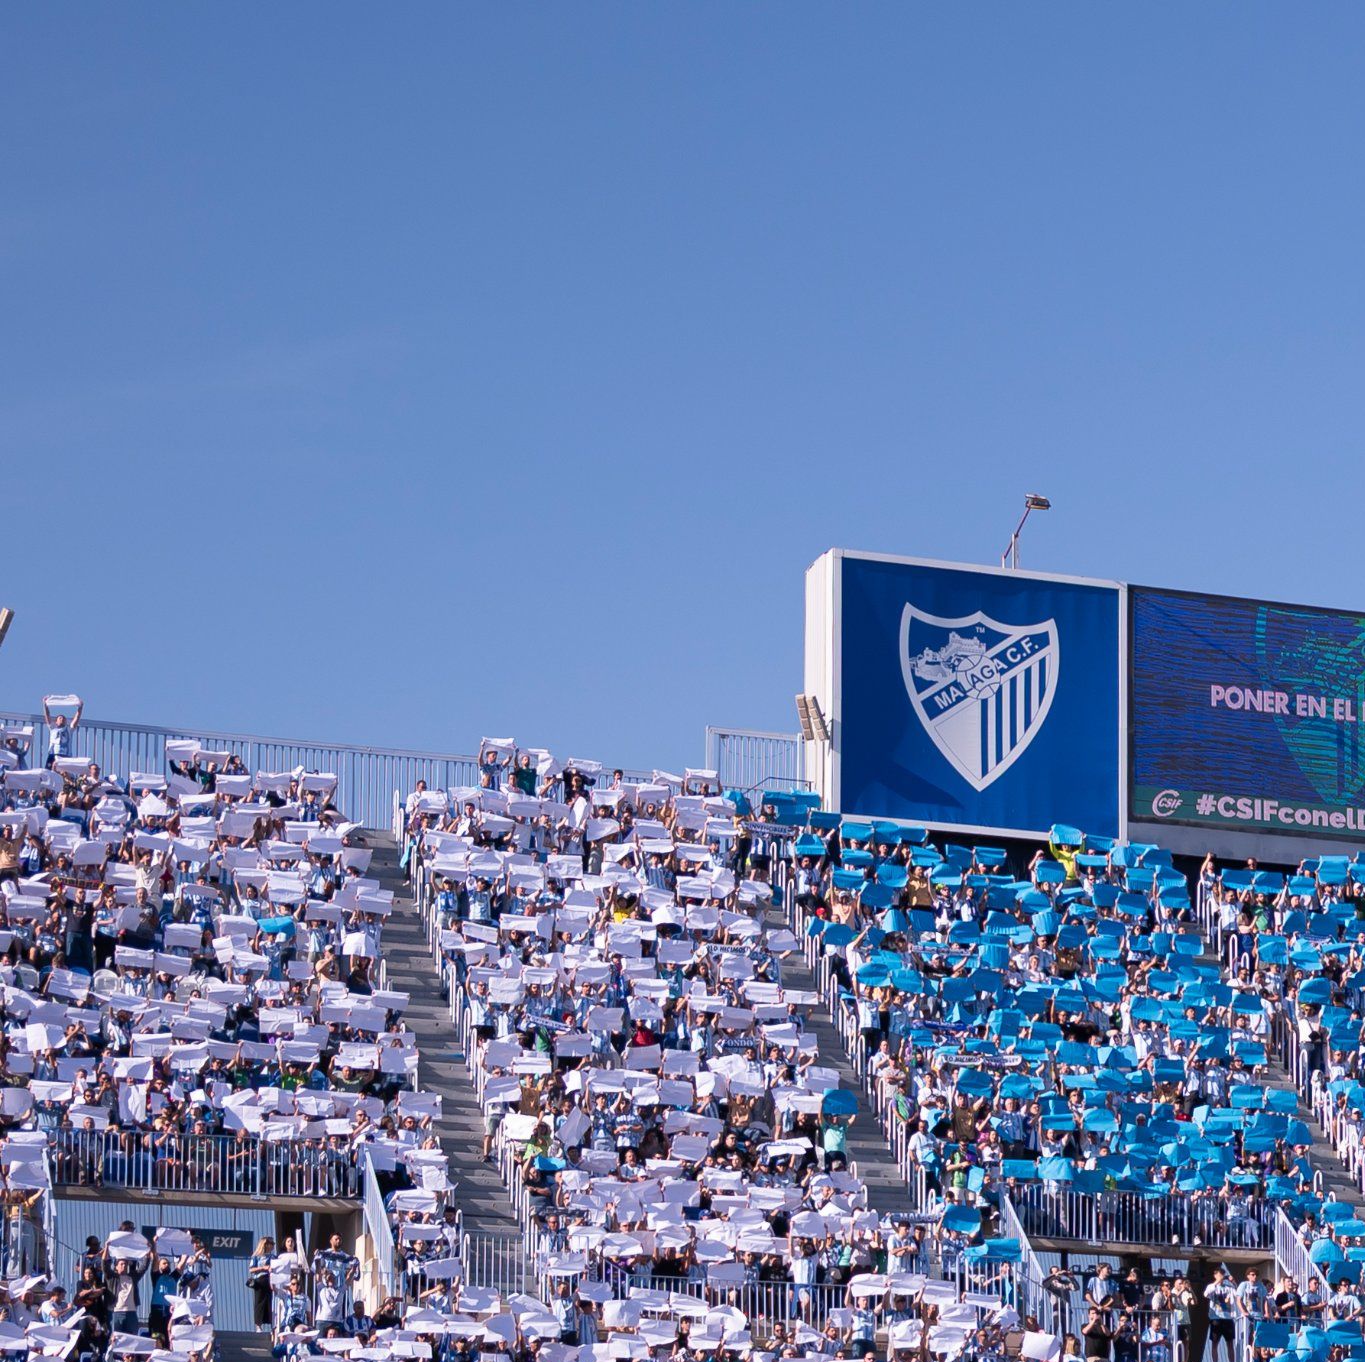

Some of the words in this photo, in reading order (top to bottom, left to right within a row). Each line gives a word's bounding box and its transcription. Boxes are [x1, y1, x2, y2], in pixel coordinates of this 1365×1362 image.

[1210, 685, 1290, 716] PONER
[1296, 697, 1327, 718] EN
[1333, 701, 1356, 721] EL
[212, 1237, 241, 1248] EXIT
